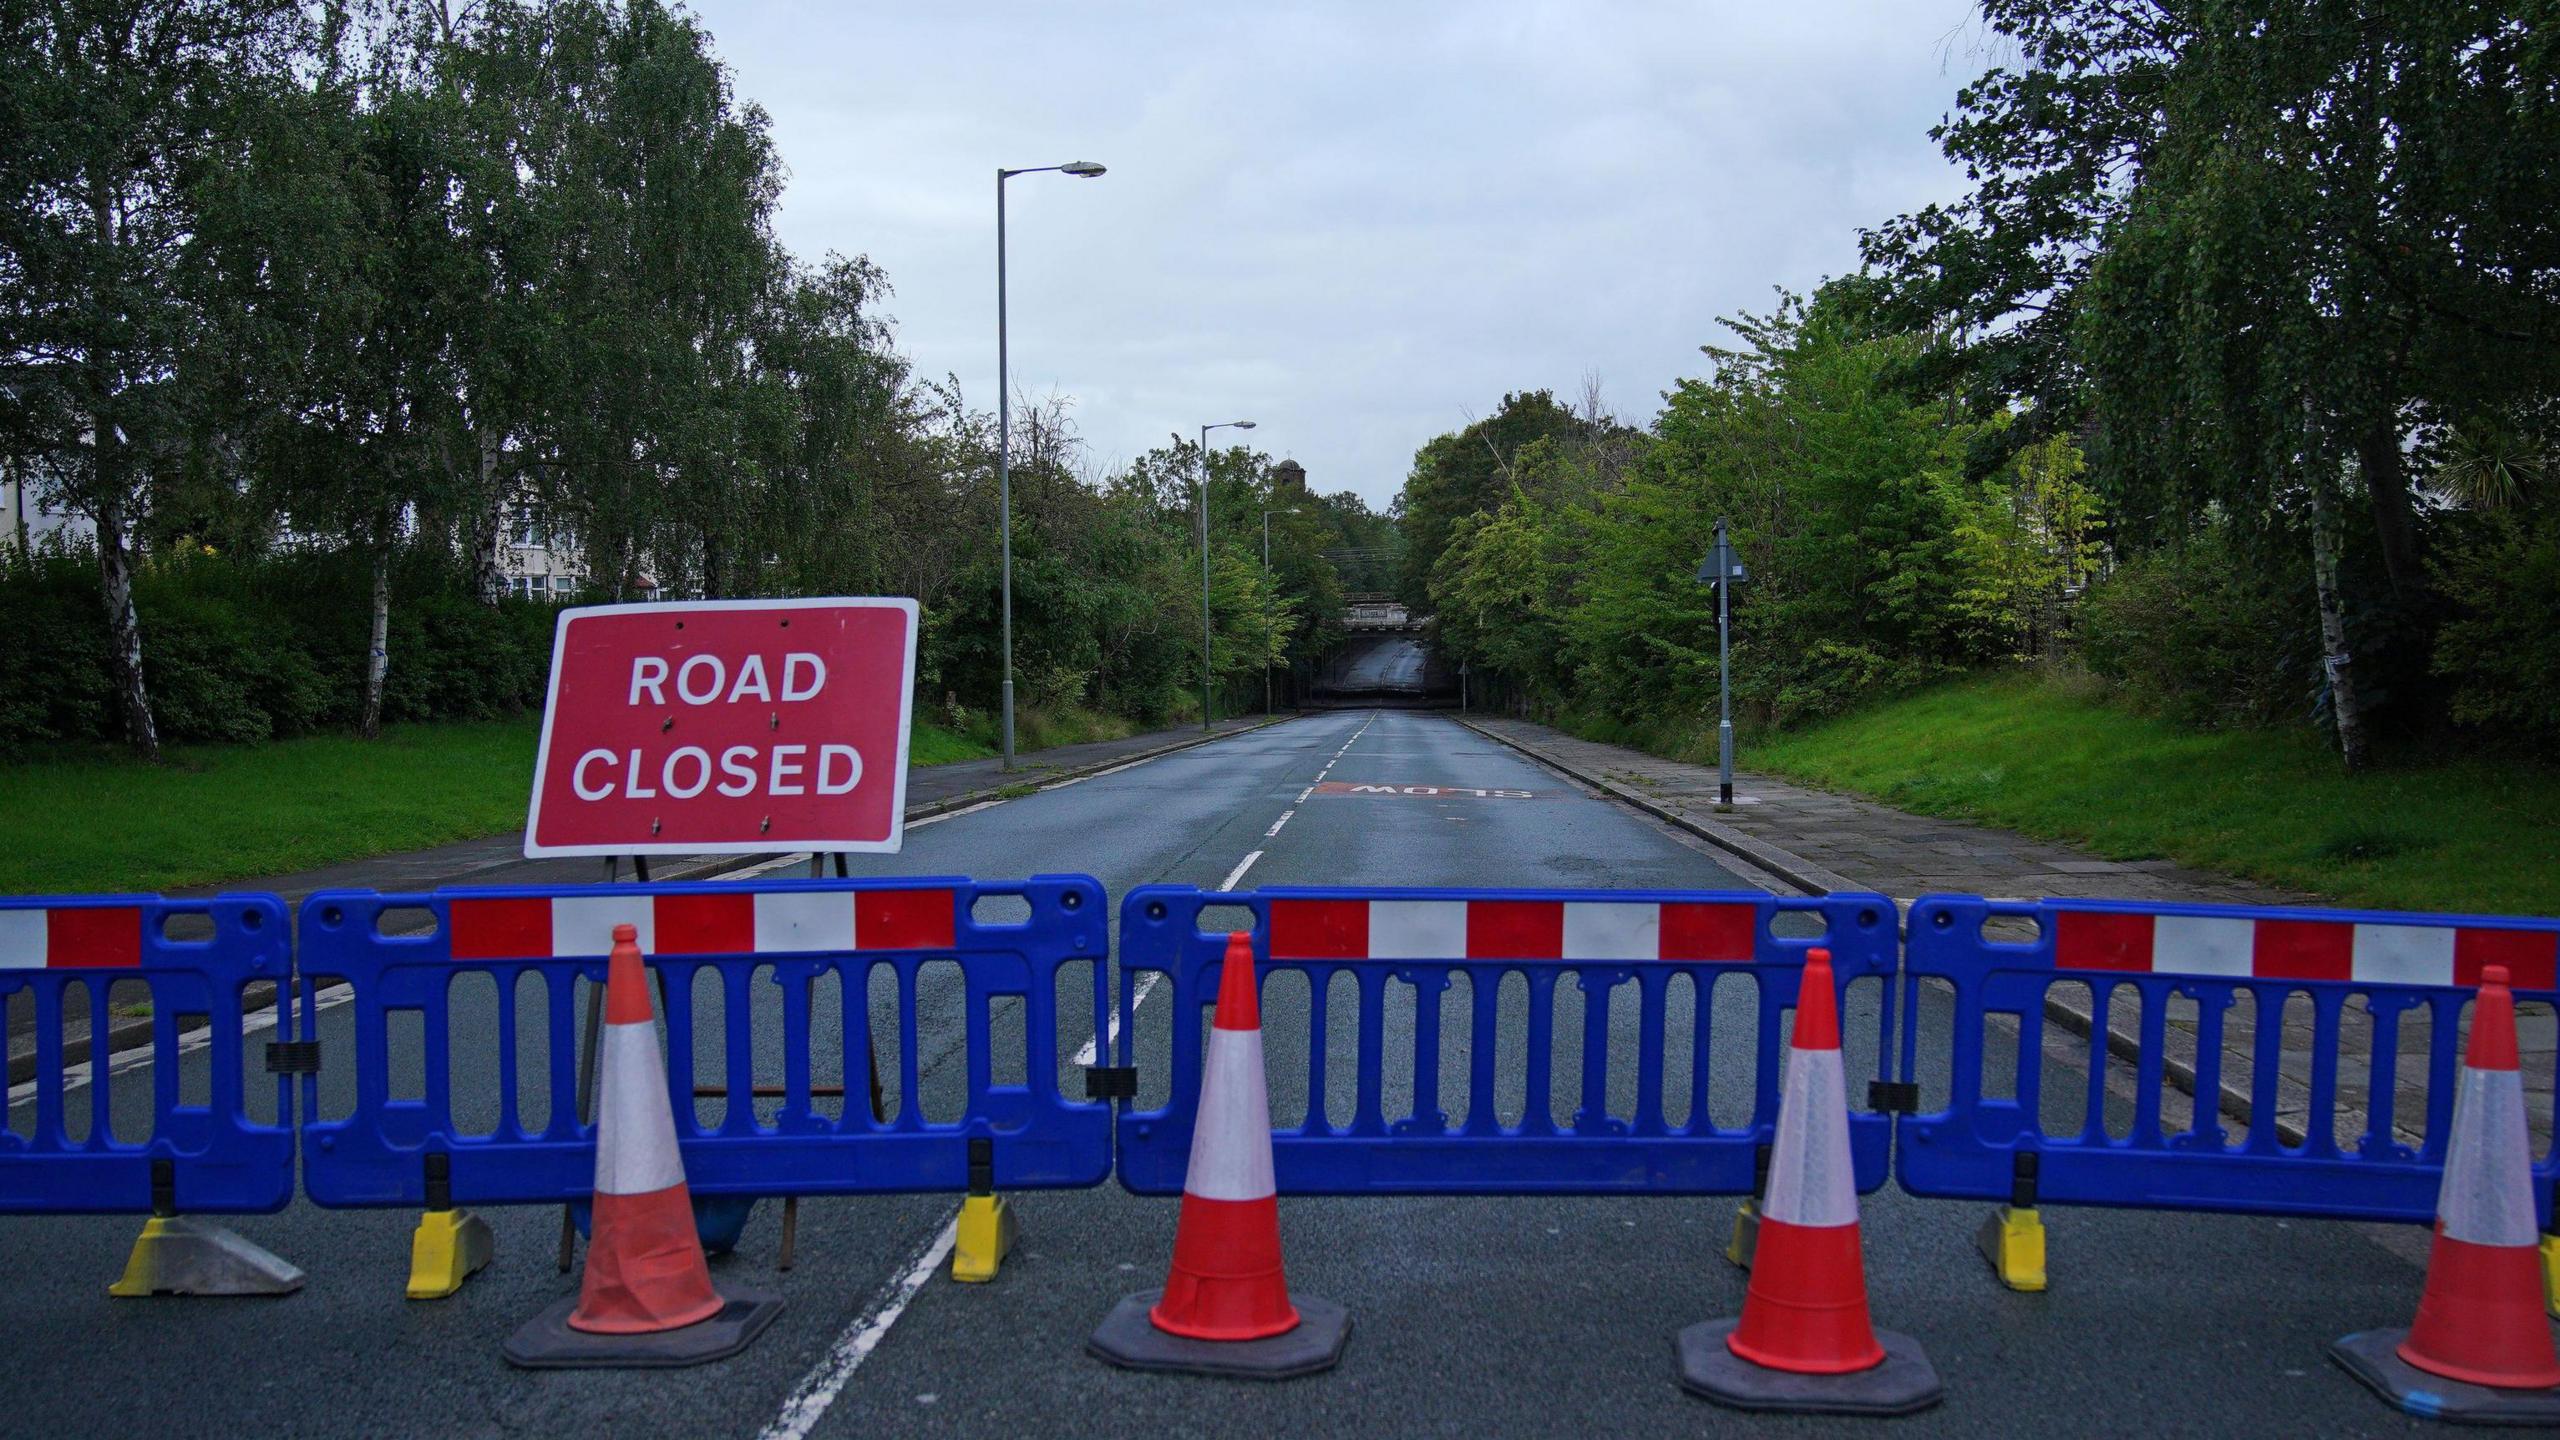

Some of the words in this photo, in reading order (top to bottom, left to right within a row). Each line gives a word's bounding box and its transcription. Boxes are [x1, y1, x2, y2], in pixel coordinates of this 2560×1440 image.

[629, 652, 827, 705] ROAD
[573, 744, 863, 801] CLOSED
[1350, 785, 1533, 798] SLOW
